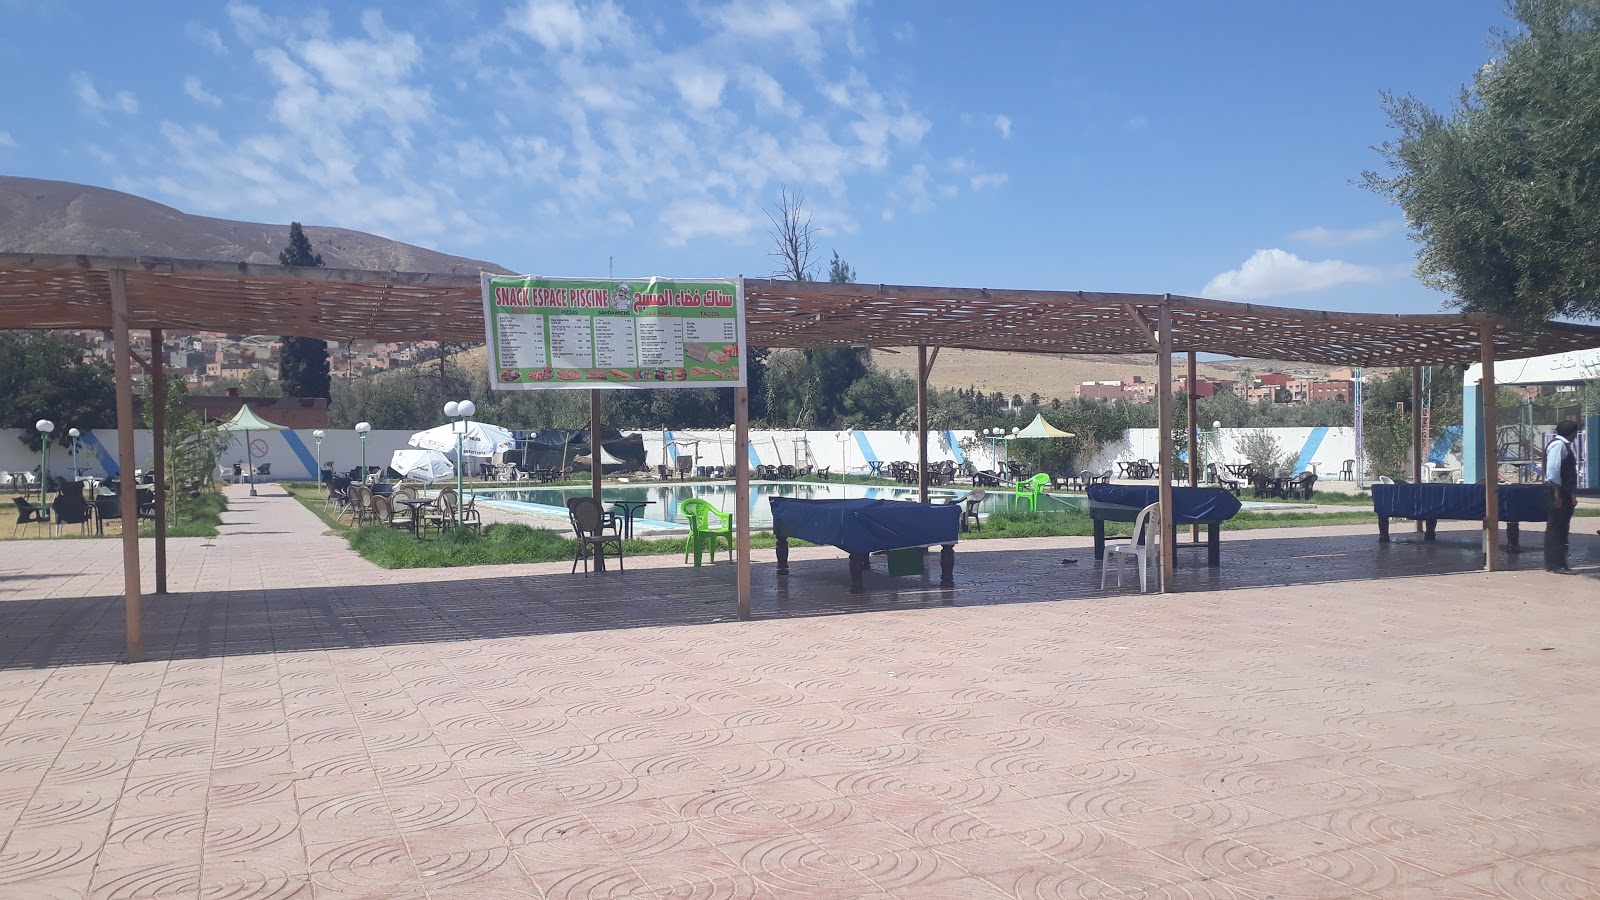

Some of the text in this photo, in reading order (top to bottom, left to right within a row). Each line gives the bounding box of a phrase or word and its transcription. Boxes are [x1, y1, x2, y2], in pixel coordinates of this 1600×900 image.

[495, 286, 609, 308] SNACK ESPACE PISCINE
[633, 289, 733, 314] سناك فضاء المسبح
